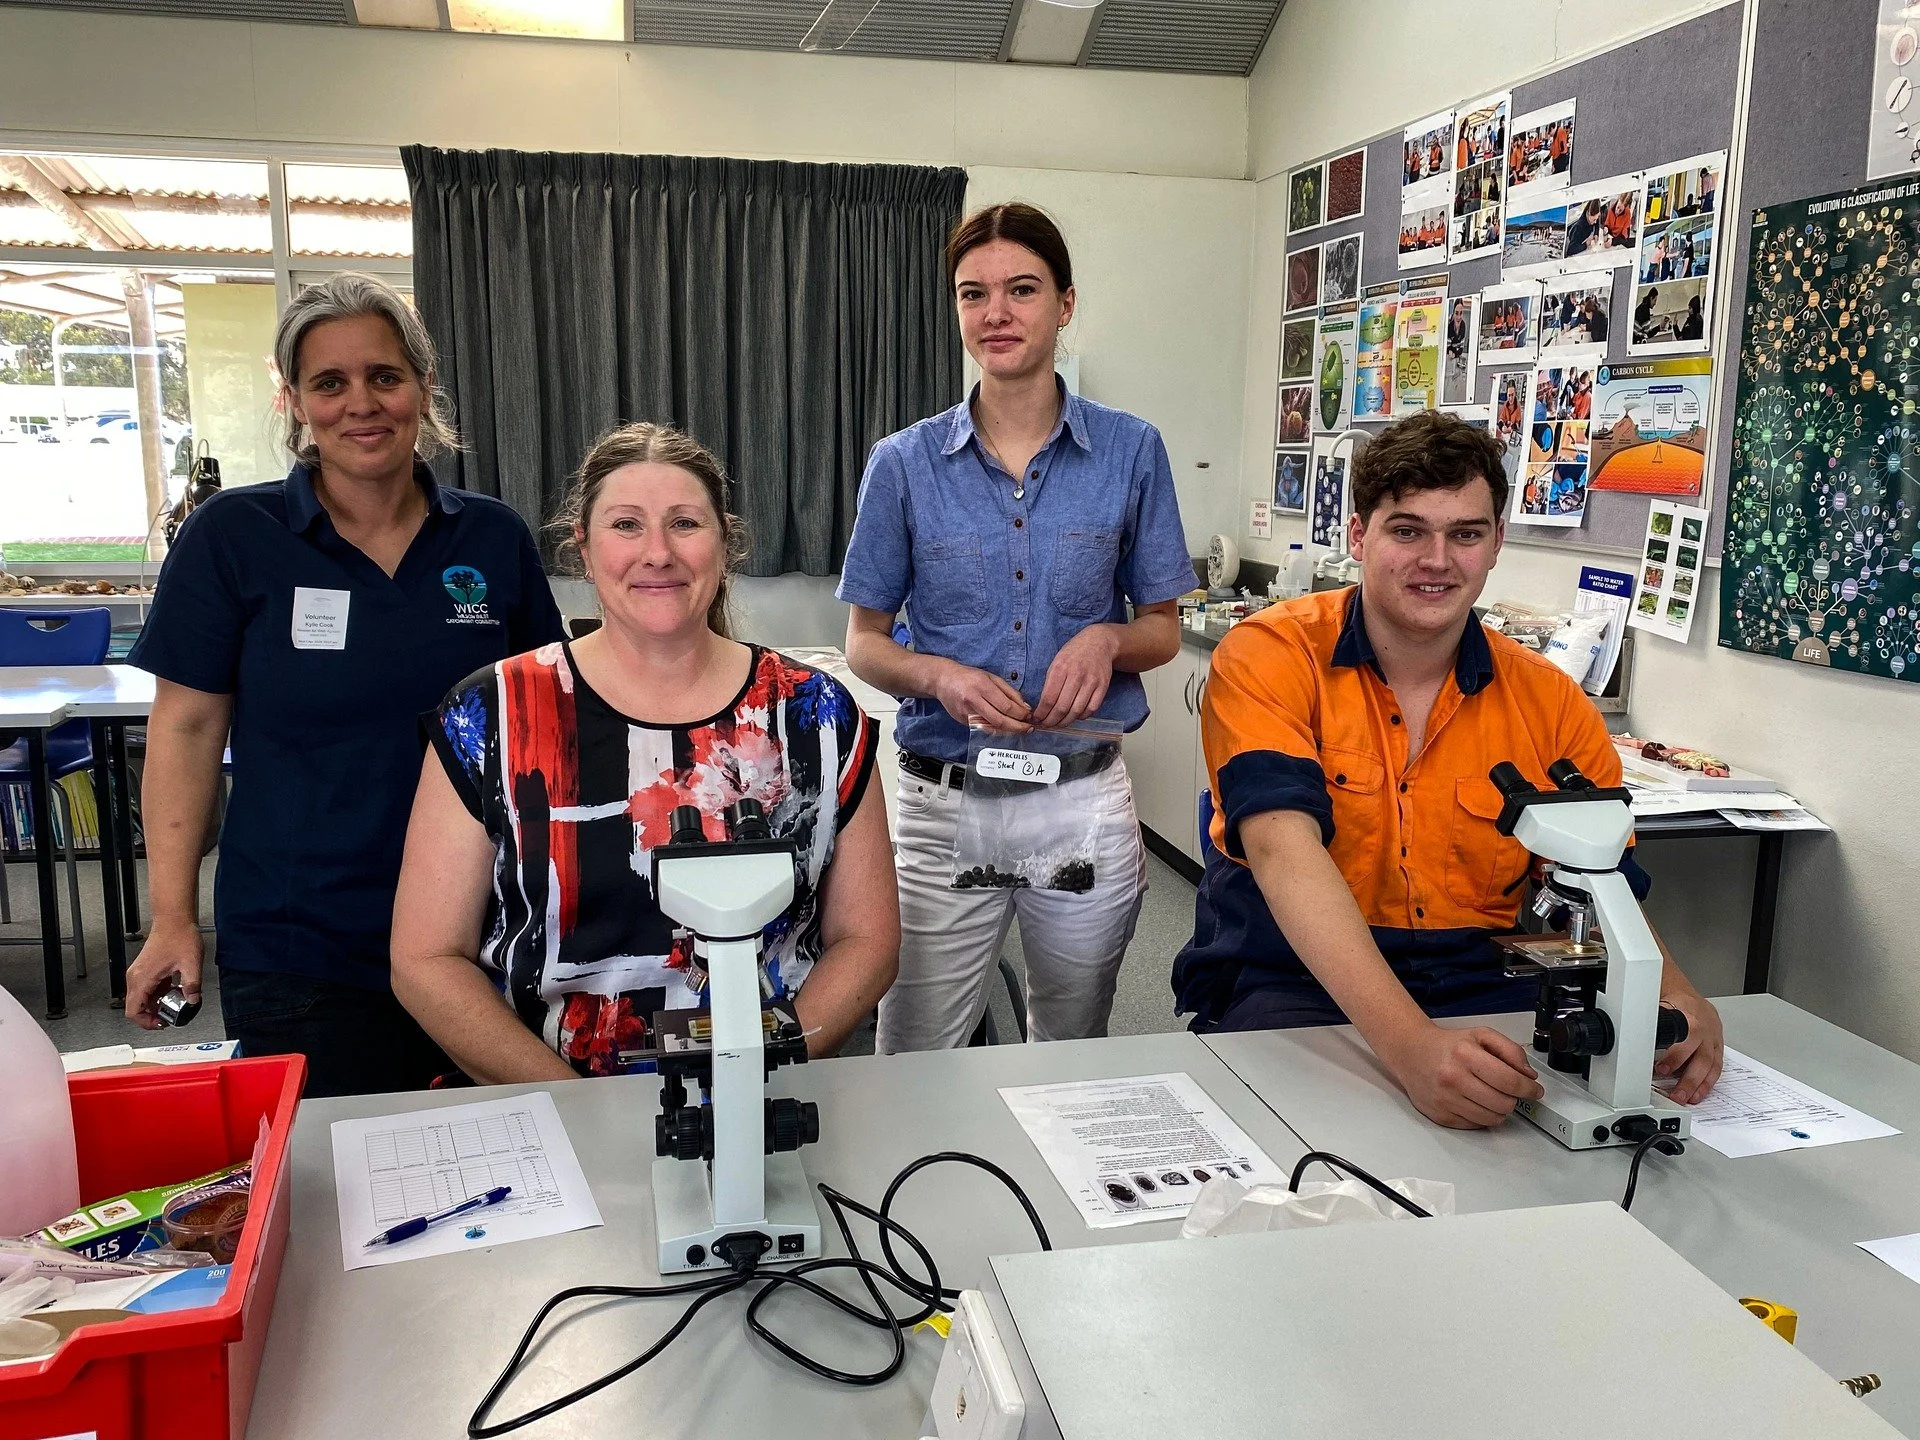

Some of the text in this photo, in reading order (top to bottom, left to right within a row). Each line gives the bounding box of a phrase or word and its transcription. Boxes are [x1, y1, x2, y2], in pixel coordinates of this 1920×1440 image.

[1807, 182, 1920, 215] EVOLUTION & CLASSIFICATION OF LIFE
[1612, 365, 1655, 376] CARBON CYCLE
[1604, 583, 1618, 591] CHART
[1609, 578, 1624, 586] WATER
[453, 603, 488, 614] WICC
[304, 613, 336, 621] Volunteer
[1803, 647, 1821, 659] LIFE
[997, 751, 1028, 761] HERCULES
[1036, 763, 1045, 776] A
[208, 1268, 226, 1277] 200
